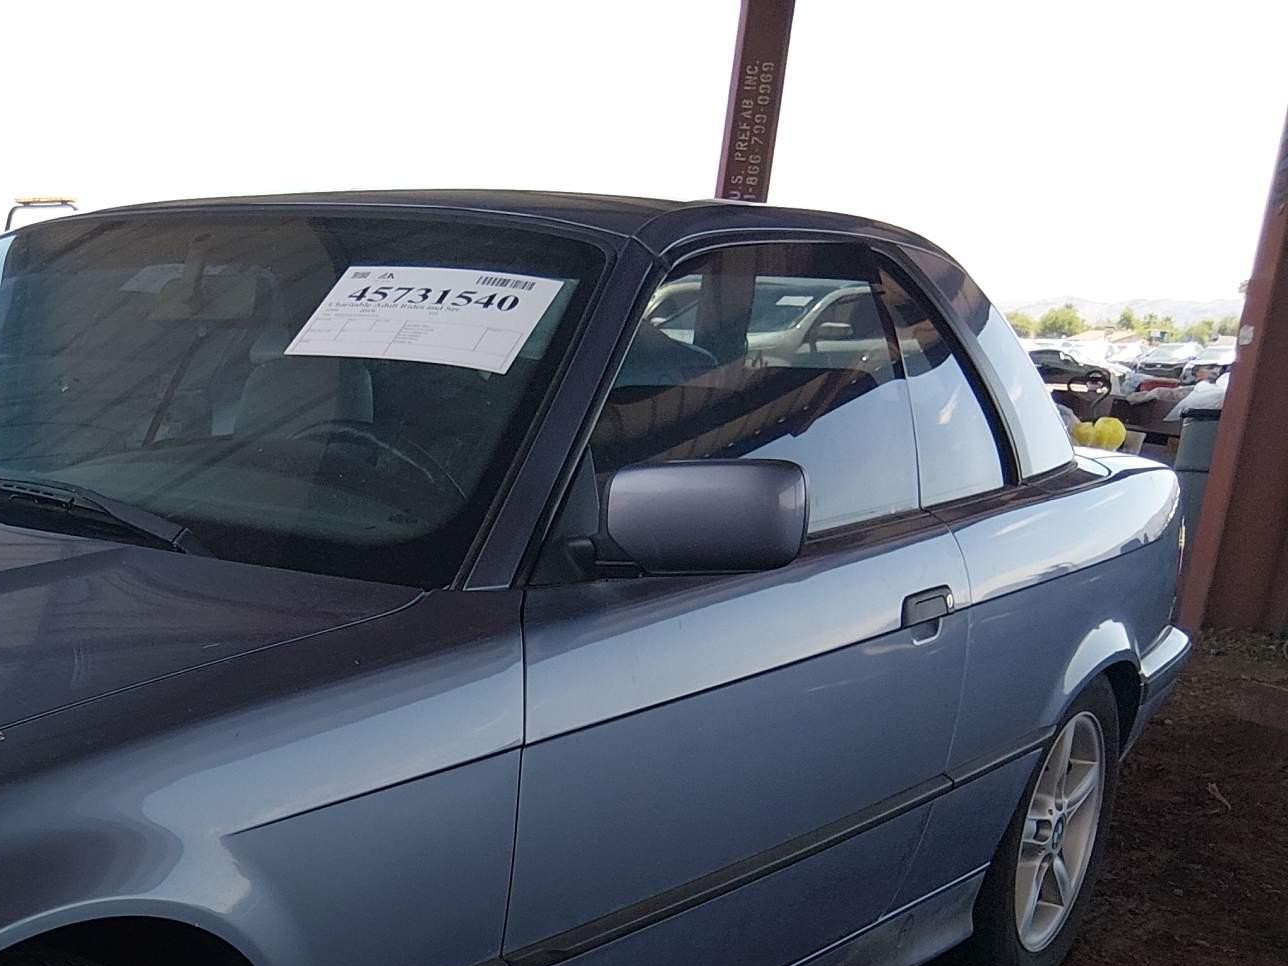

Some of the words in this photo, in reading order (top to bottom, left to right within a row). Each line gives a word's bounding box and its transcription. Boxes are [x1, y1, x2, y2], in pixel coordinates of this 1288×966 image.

[743, 60, 760, 90] INC.
[734, 98, 754, 162] PREFAB
[743, 61, 775, 199] 1-866-799-0969
[728, 170, 745, 200] U.S.
[348, 285, 520, 311] 45731540
